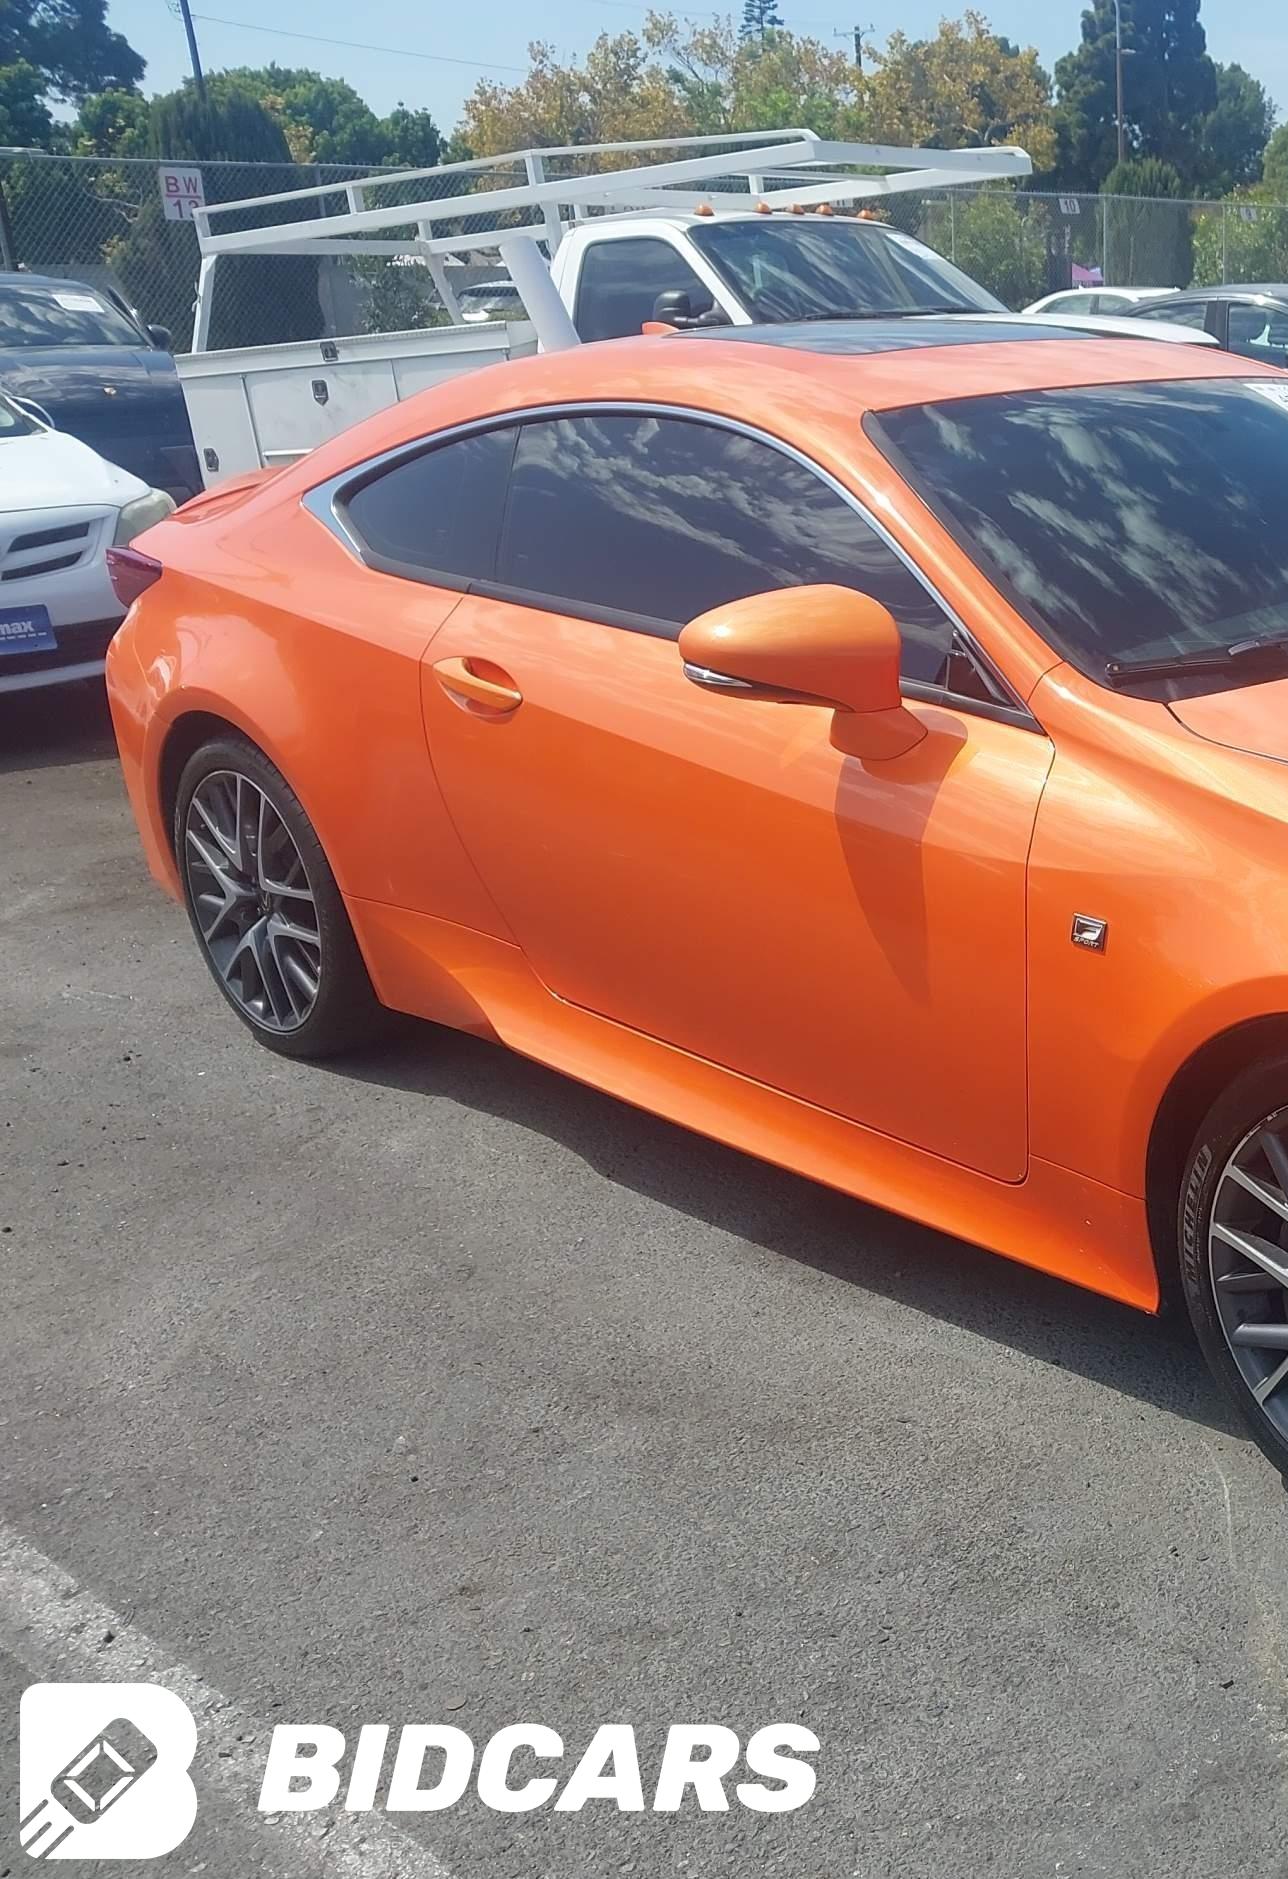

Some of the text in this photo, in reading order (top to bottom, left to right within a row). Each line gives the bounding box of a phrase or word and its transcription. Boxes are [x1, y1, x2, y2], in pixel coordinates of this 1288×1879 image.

[1064, 199, 1076, 211] 10
[1074, 936, 1100, 948] SPORT
[1184, 1146, 1211, 1282] MICHELIN
